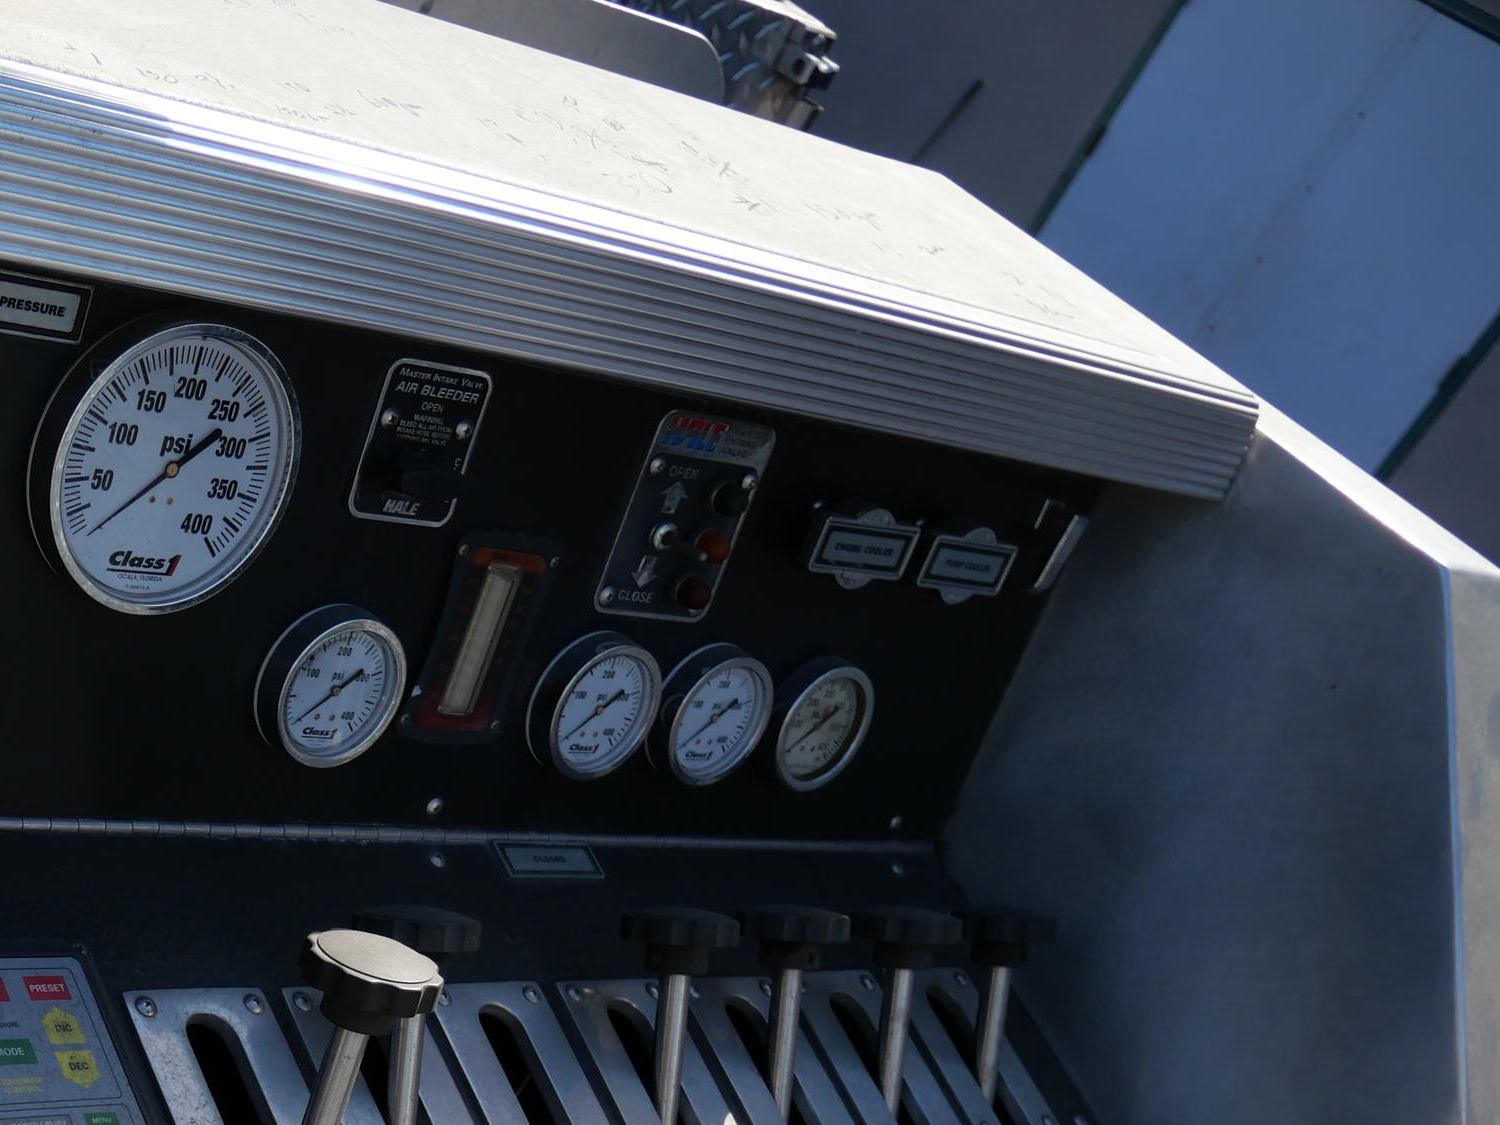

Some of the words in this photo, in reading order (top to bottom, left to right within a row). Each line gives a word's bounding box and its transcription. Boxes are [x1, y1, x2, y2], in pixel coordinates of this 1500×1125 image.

[0, 296, 66, 318] PRESSURE
[174, 376, 207, 400] 200
[395, 381, 419, 395] AIR
[420, 385, 480, 404] BLEEDER
[136, 389, 167, 413] 150
[208, 399, 240, 422] 250
[422, 402, 444, 413] OPEN
[108, 422, 138, 446] 100
[159, 434, 194, 456] psi
[215, 436, 246, 459] 300
[91, 470, 114, 491] 50
[669, 465, 699, 479] OPEN
[207, 478, 238, 500] 350
[382, 499, 420, 516] HALE
[180, 513, 212, 534] 400
[618, 589, 653, 603] CLOSE
[337, 646, 353, 656] 200
[306, 669, 320, 678] 100
[331, 671, 344, 681] psi
[341, 712, 354, 721] 400
[29, 984, 65, 993] PRESET
[55, 1023, 72, 1032] INC
[69, 1061, 89, 1070] DEC
